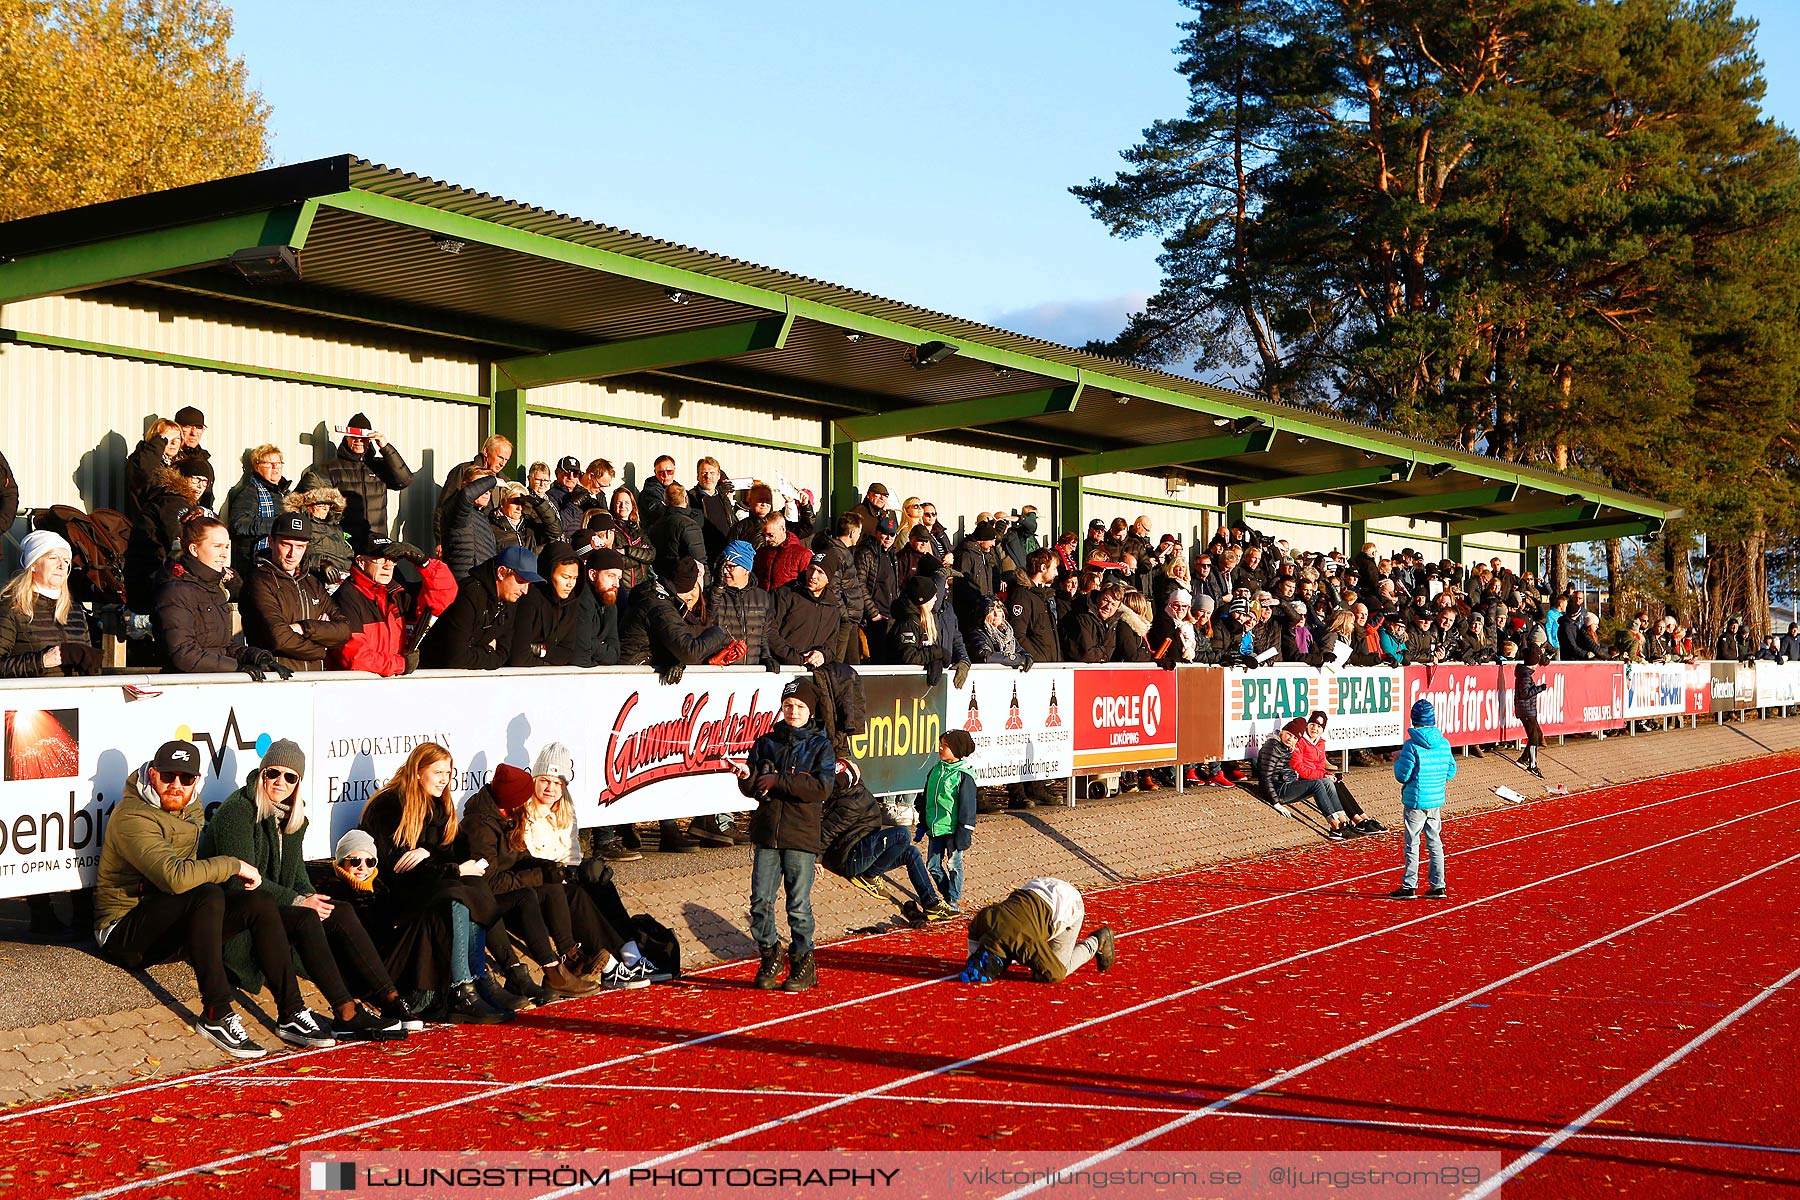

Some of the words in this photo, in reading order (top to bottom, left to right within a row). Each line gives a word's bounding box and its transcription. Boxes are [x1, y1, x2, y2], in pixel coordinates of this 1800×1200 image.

[1092, 695, 1140, 728] CIRCLE
[1241, 677, 1309, 720] PEAB
[1336, 676, 1392, 715] PEAB
[1410, 673, 1461, 734] Fmåt
[1462, 675, 1484, 732] för
[1583, 706, 1601, 722] SVENSKA
[1602, 705, 1612, 720] SPEL
[846, 698, 940, 760] emblin
[1109, 729, 1140, 746] LIDKÖPING
[21, 859, 61, 874] ÖPPNA
[65, 854, 101, 870] STADS
